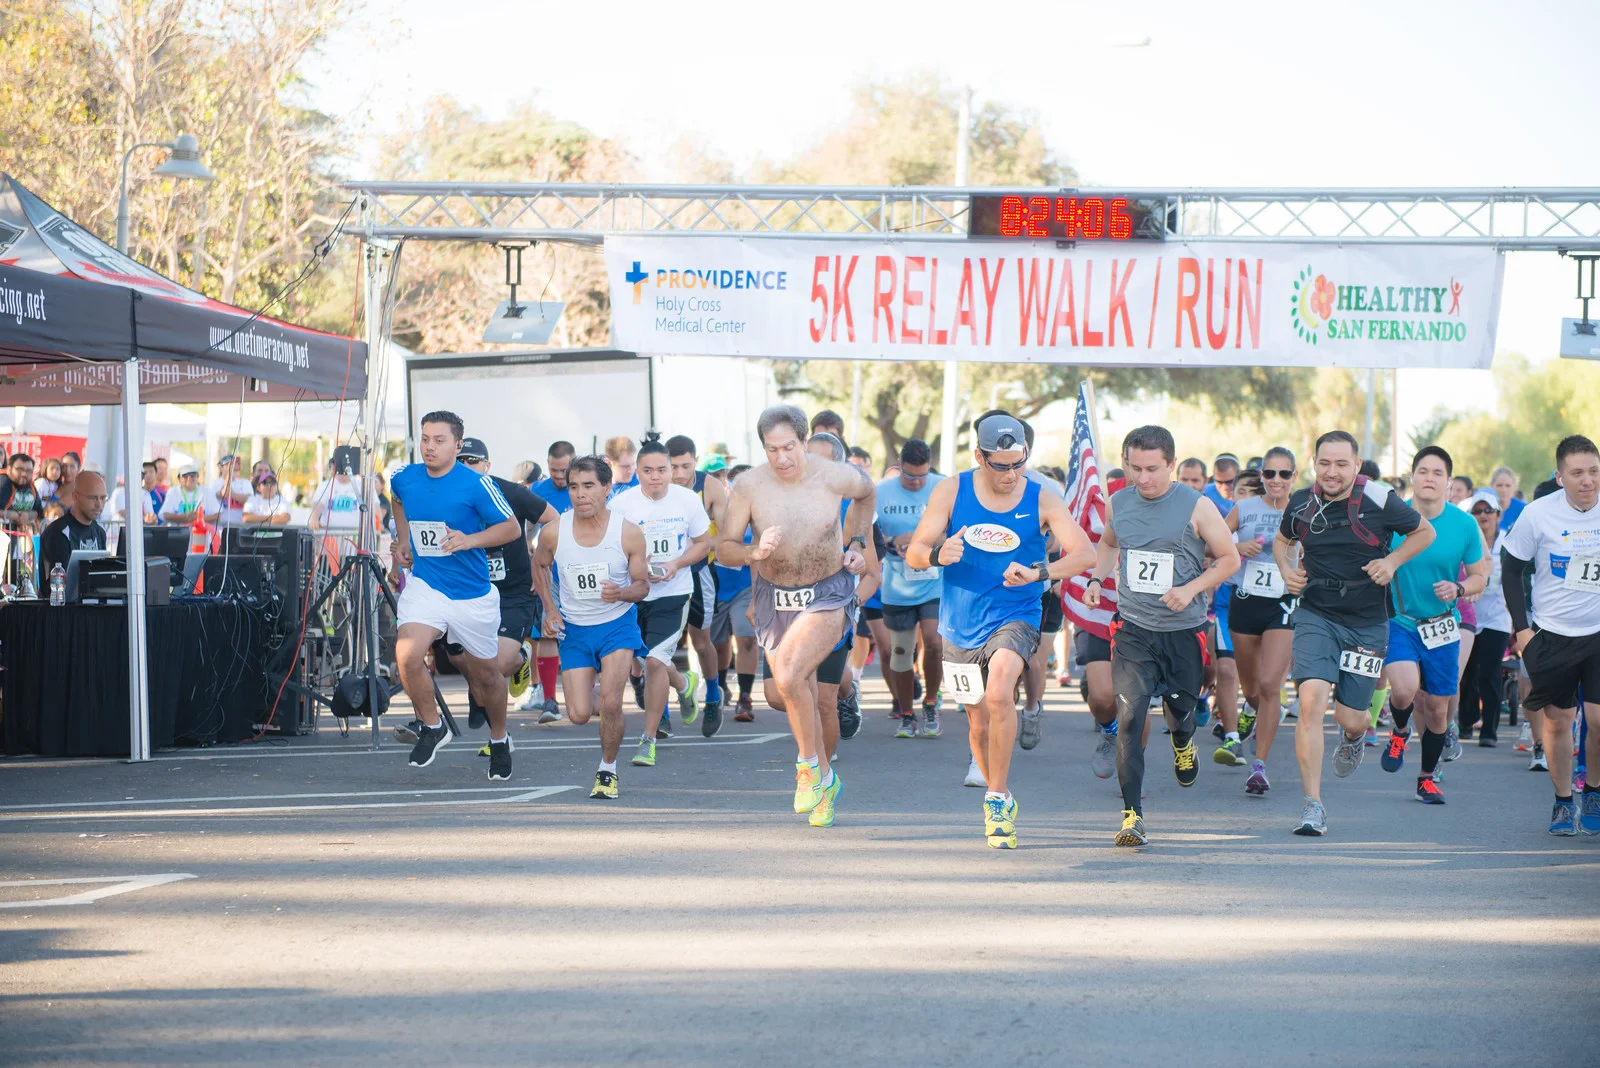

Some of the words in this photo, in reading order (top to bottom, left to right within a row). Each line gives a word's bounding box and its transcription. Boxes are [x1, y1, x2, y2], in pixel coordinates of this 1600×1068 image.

[1000, 196, 1132, 239] 8:24:06
[656, 268, 788, 291] PROVIDENCE
[655, 295, 685, 315] Holy
[688, 296, 722, 313] Cross
[809, 255, 860, 344] 5K
[872, 255, 1006, 346] RELAY
[1017, 257, 1138, 347] WALK
[1147, 256, 1163, 349] /
[1175, 257, 1264, 350] RUN
[1336, 285, 1448, 313] HEALTHY
[655, 316, 704, 333] Medical
[706, 317, 747, 334] Center
[1327, 319, 1364, 340] SAN
[1367, 320, 1467, 342] FERNANDO
[209, 325, 310, 373] www.onetimeracing.net
[420, 530, 438, 547] 82
[653, 539, 669, 554] 10
[1138, 561, 1159, 581] 27
[1254, 569, 1273, 588] 21
[1580, 562, 1600, 582] 13
[577, 573, 597, 590] 88
[775, 590, 813, 607] 1142
[1421, 618, 1455, 640] 1139
[1342, 652, 1381, 674] 1140
[953, 673, 971, 692] 19
